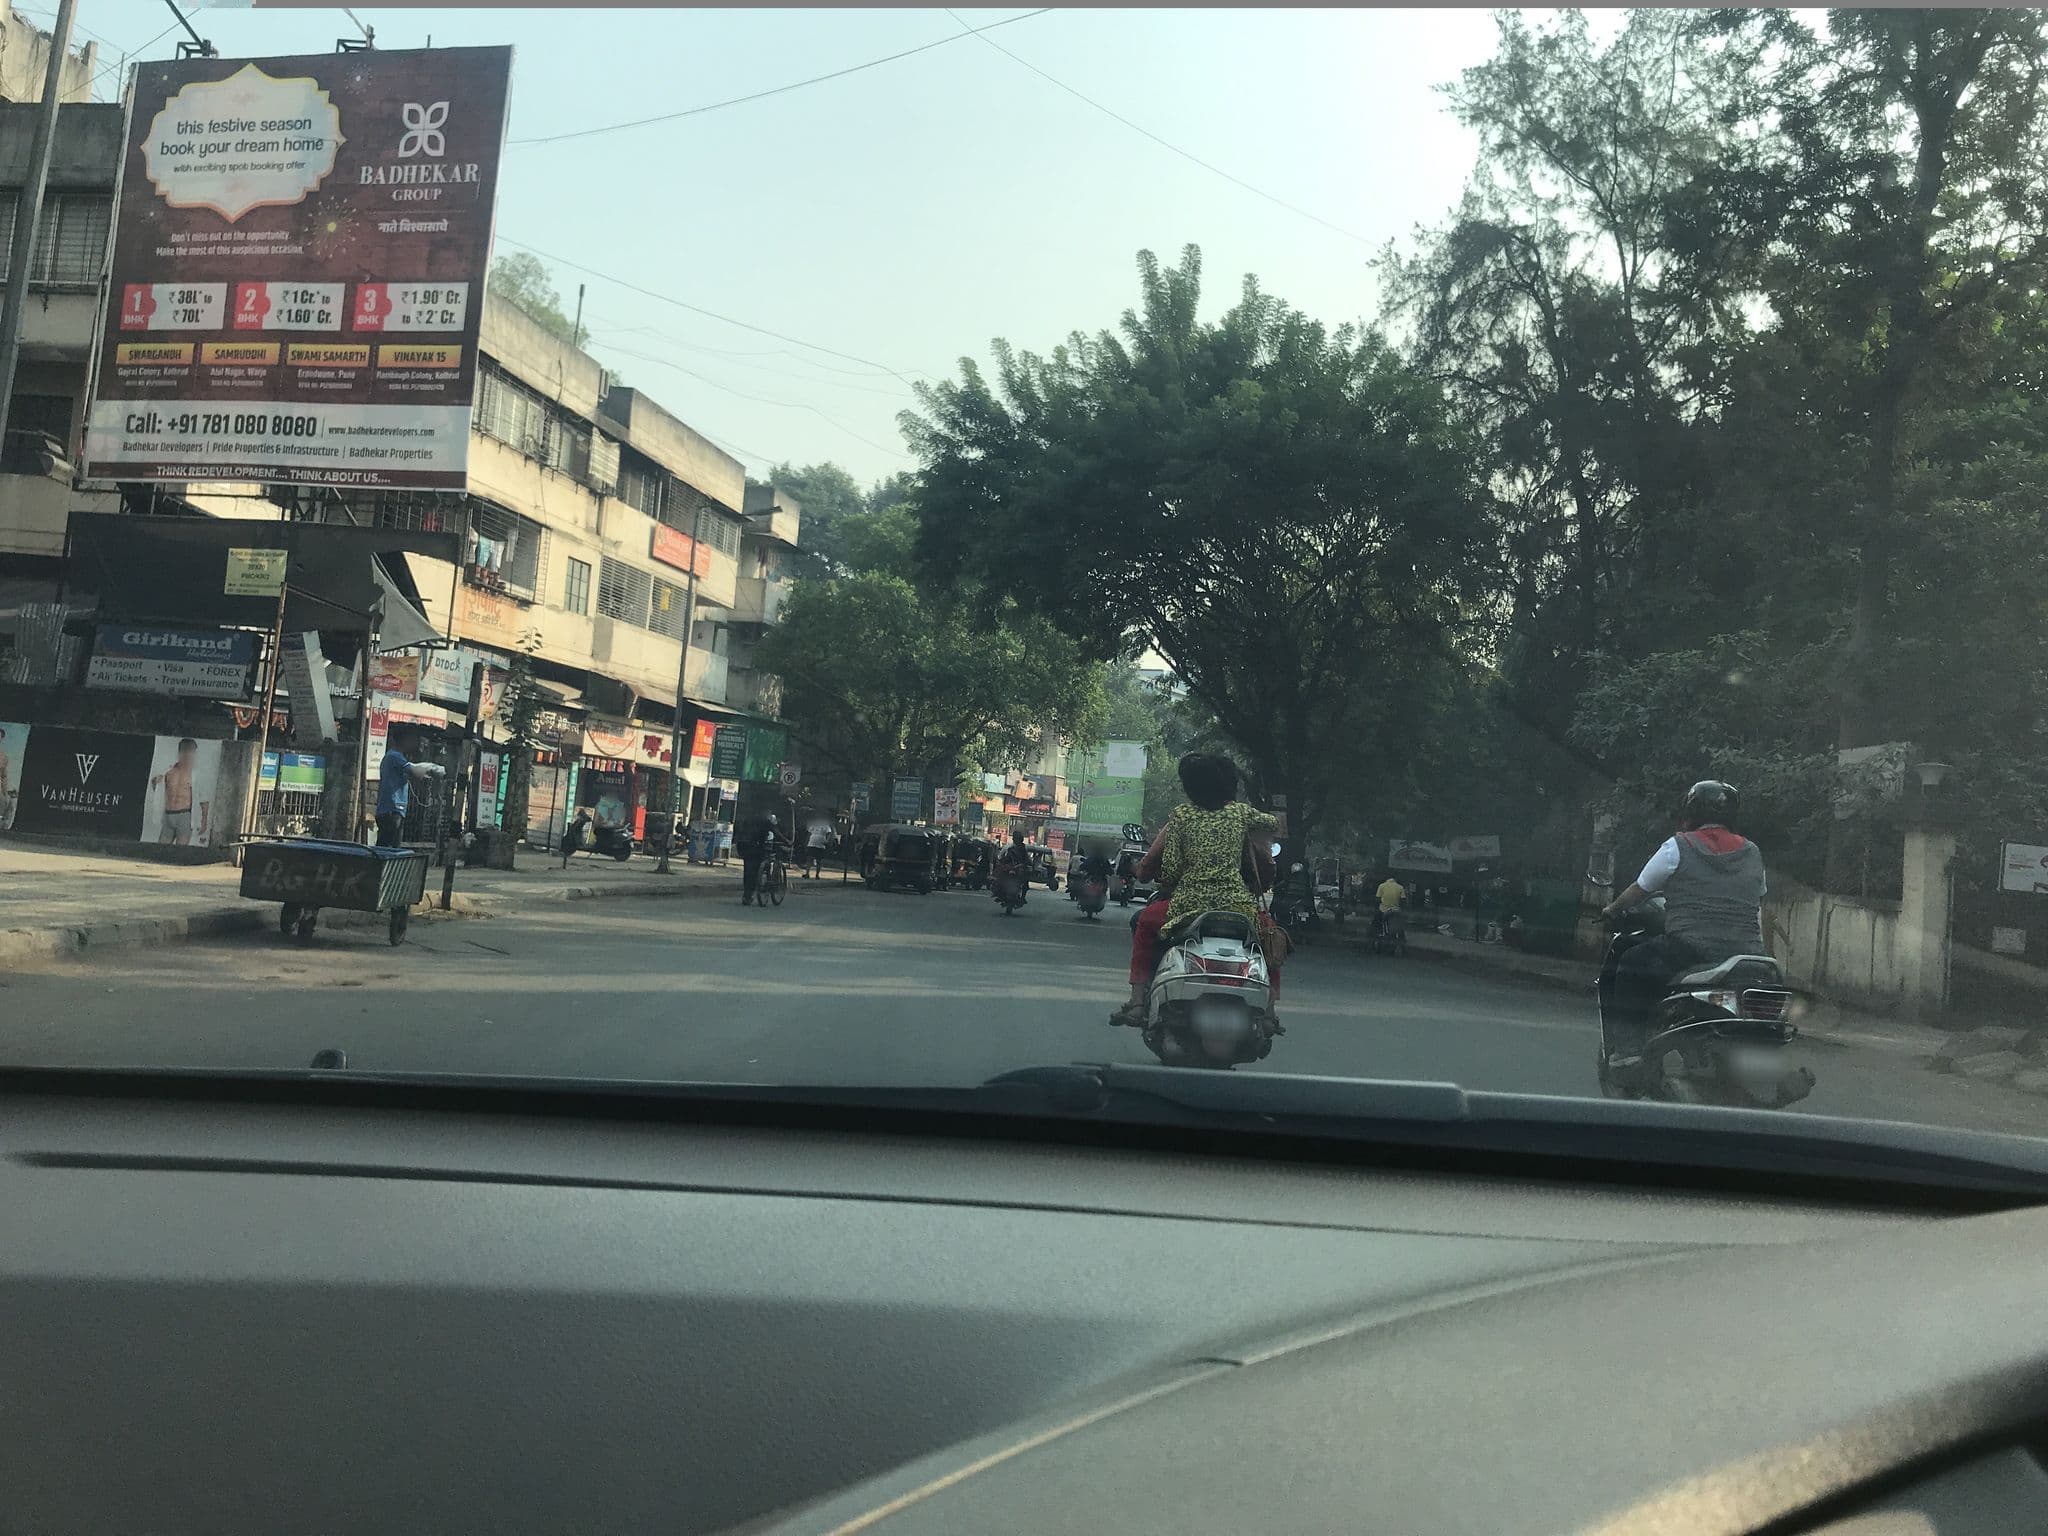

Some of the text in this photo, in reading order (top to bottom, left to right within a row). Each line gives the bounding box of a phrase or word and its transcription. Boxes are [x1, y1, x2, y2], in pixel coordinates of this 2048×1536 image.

[177, 118, 312, 135] this festive season
[160, 138, 324, 158] book your dream home
[173, 160, 306, 174] with exciting spot booking offer
[359, 163, 479, 185] BADHEKAR
[391, 188, 442, 202] GROUP
[156, 246, 175, 256] Make
[176, 246, 188, 256] the
[188, 246, 207, 255] most
[133, 291, 143, 312] 1
[204, 295, 213, 304] to
[244, 289, 256, 312] 2
[321, 295, 330, 304] to
[364, 289, 377, 312] 3
[124, 315, 145, 324] BHK
[237, 314, 259, 323] BHK
[357, 315, 379, 324] BHK
[402, 314, 411, 324] to
[128, 349, 182, 361] SWARGANDH
[214, 349, 267, 360] SAMRUDDHI
[290, 350, 367, 362] SWAMI SAMARTH
[393, 351, 446, 363] VINAYAK 15
[126, 412, 317, 437] Call: +91 781 080 8080
[328, 425, 435, 438] www.badhekardevelopers.com
[122, 441, 203, 453] Badhekar Developers
[213, 441, 339, 457] Pride Properties & Infrastructure
[349, 447, 433, 460] Badhekar Properties
[156, 466, 186, 476] THINK
[290, 469, 322, 481] THINK
[323, 471, 363, 482] ABOUT
[121, 631, 233, 651] Girikand
[100, 659, 143, 671] Passport
[163, 663, 184, 673] Visa
[97, 672, 147, 684] Air Tickets
[206, 666, 241, 678] FOREX
[161, 675, 239, 689] Travel Insurance
